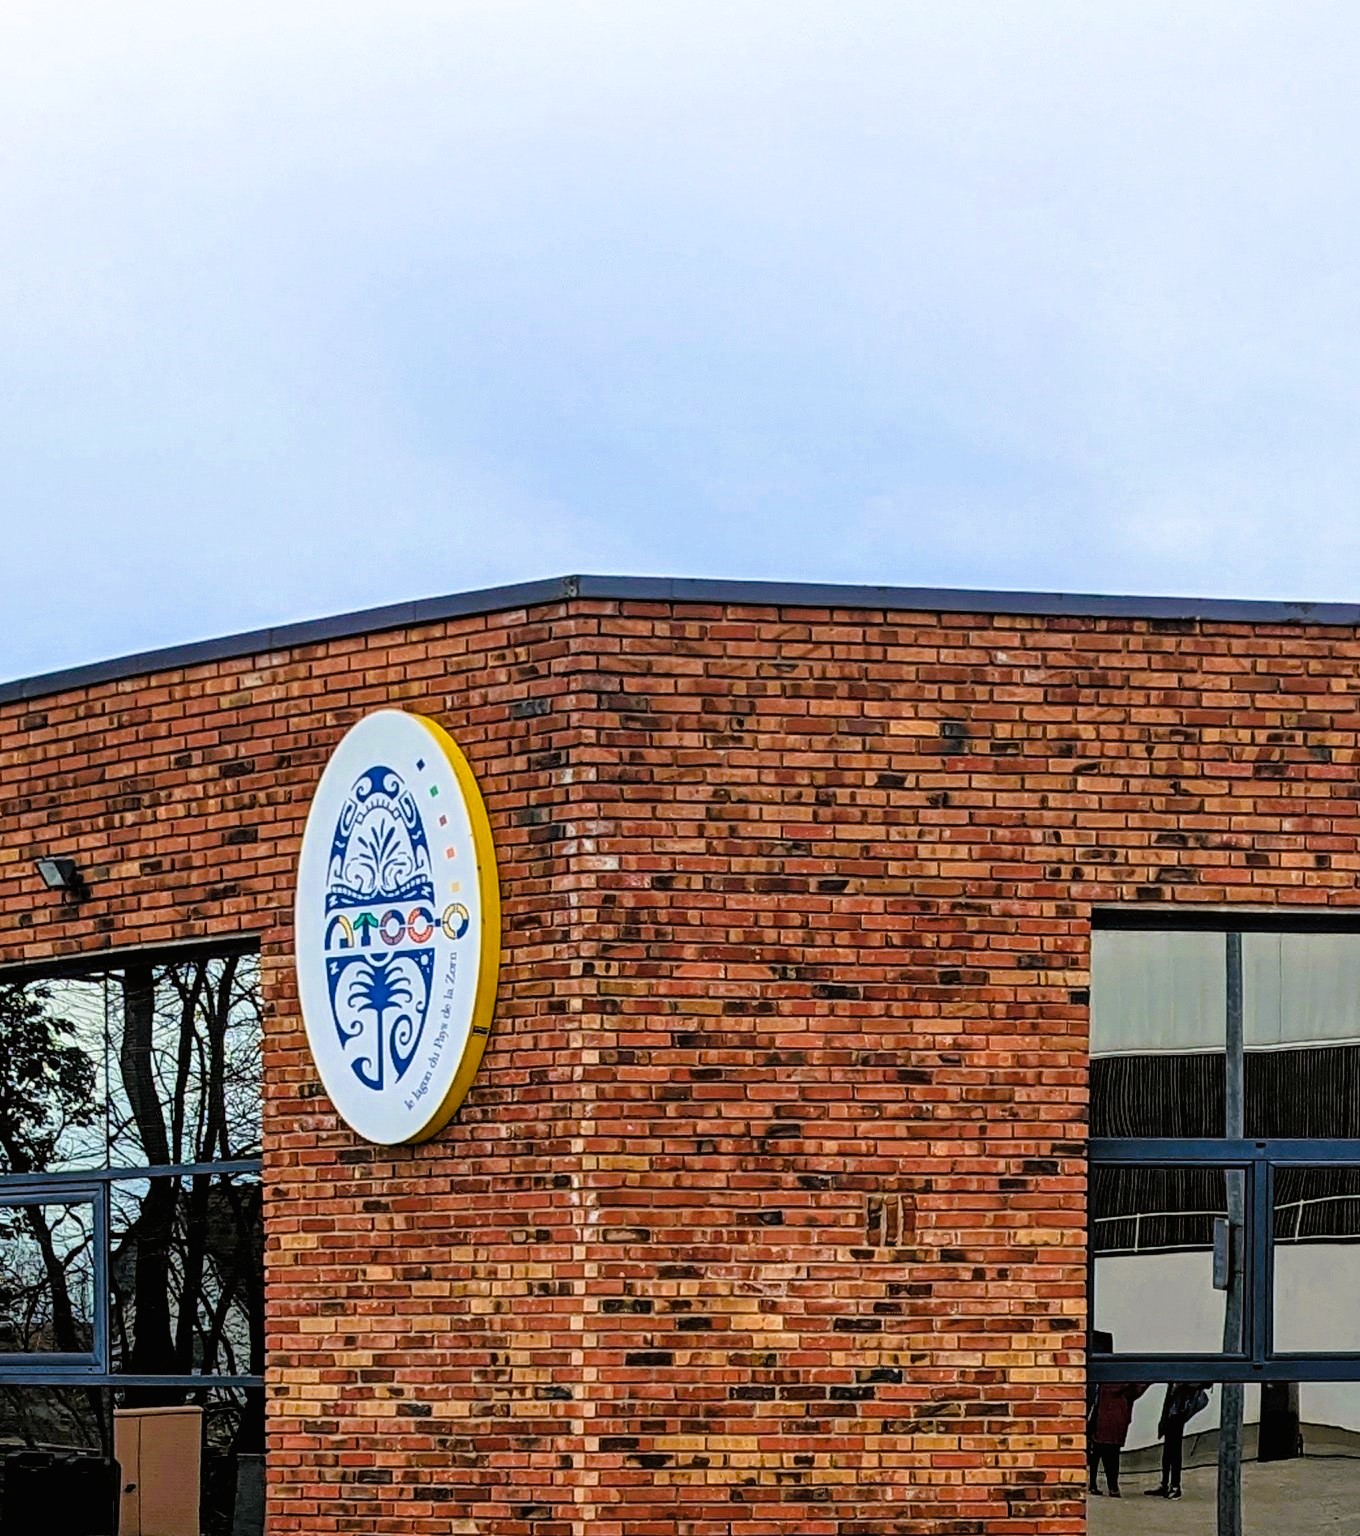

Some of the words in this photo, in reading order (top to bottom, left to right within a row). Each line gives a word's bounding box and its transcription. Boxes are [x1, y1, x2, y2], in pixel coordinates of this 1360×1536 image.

[445, 951, 458, 985] Zorn
[443, 987, 454, 1001] la
[441, 1003, 452, 1020] de
[433, 1022, 449, 1050] Pays
[412, 1069, 433, 1101] lagon
